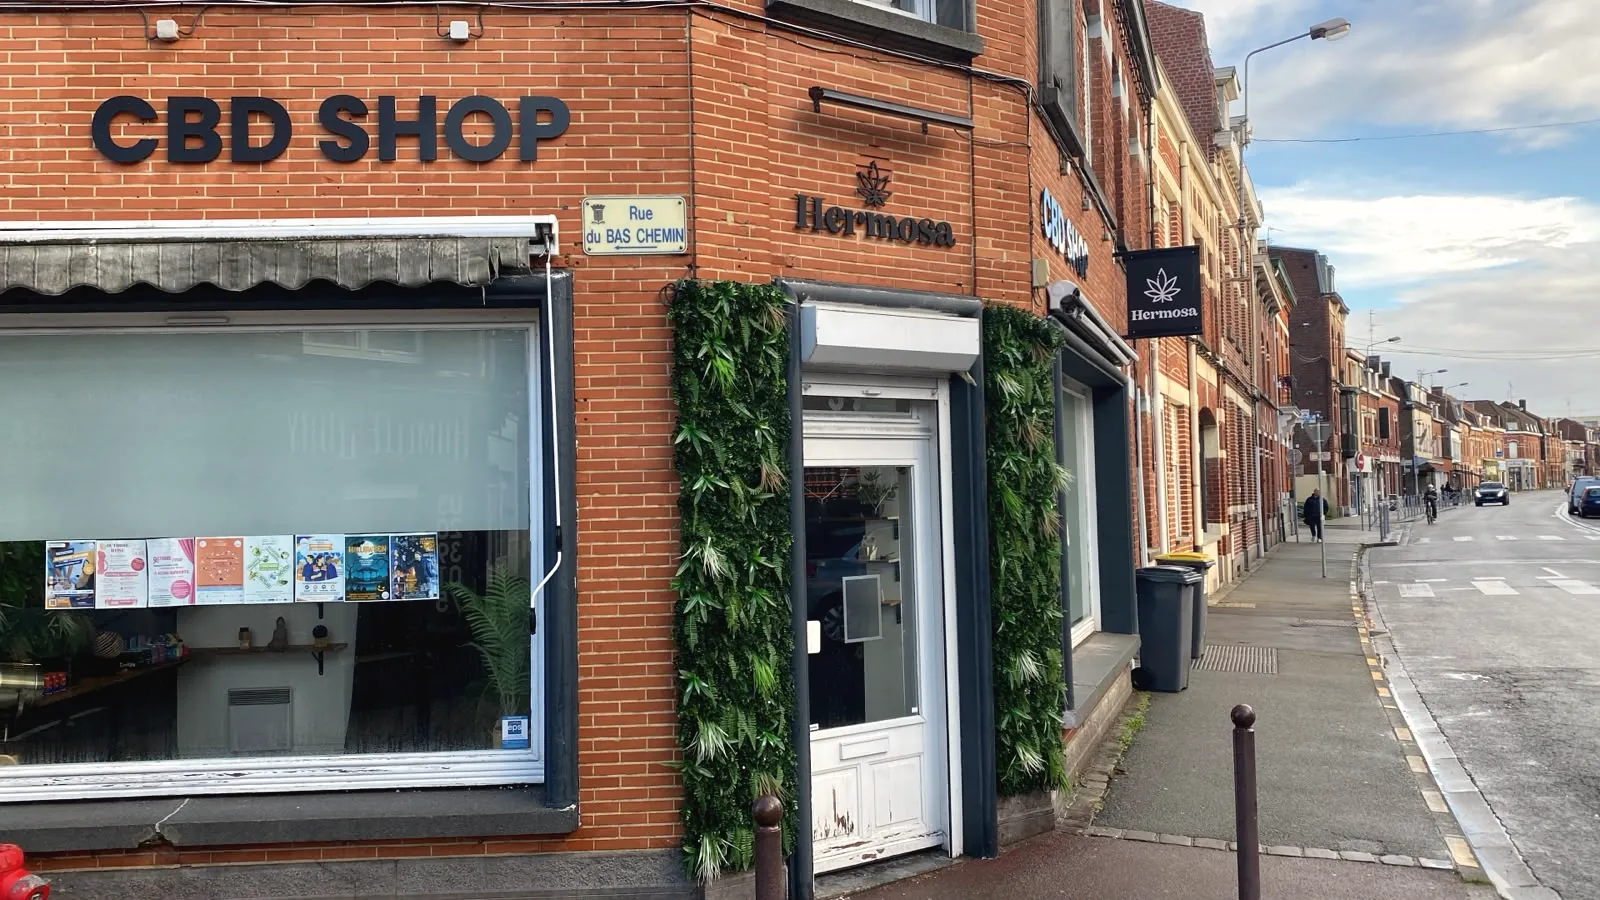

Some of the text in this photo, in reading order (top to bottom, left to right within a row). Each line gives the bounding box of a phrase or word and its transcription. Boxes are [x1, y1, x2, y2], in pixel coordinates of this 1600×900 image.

[92, 95, 571, 163] CBD SHOP
[629, 206, 654, 220] Rue
[793, 193, 957, 248] Hermosa
[586, 228, 685, 244] du BAS CHEMIN
[1041, 187, 1089, 281] CBD SHOP
[1131, 307, 1199, 321] Hermosa
